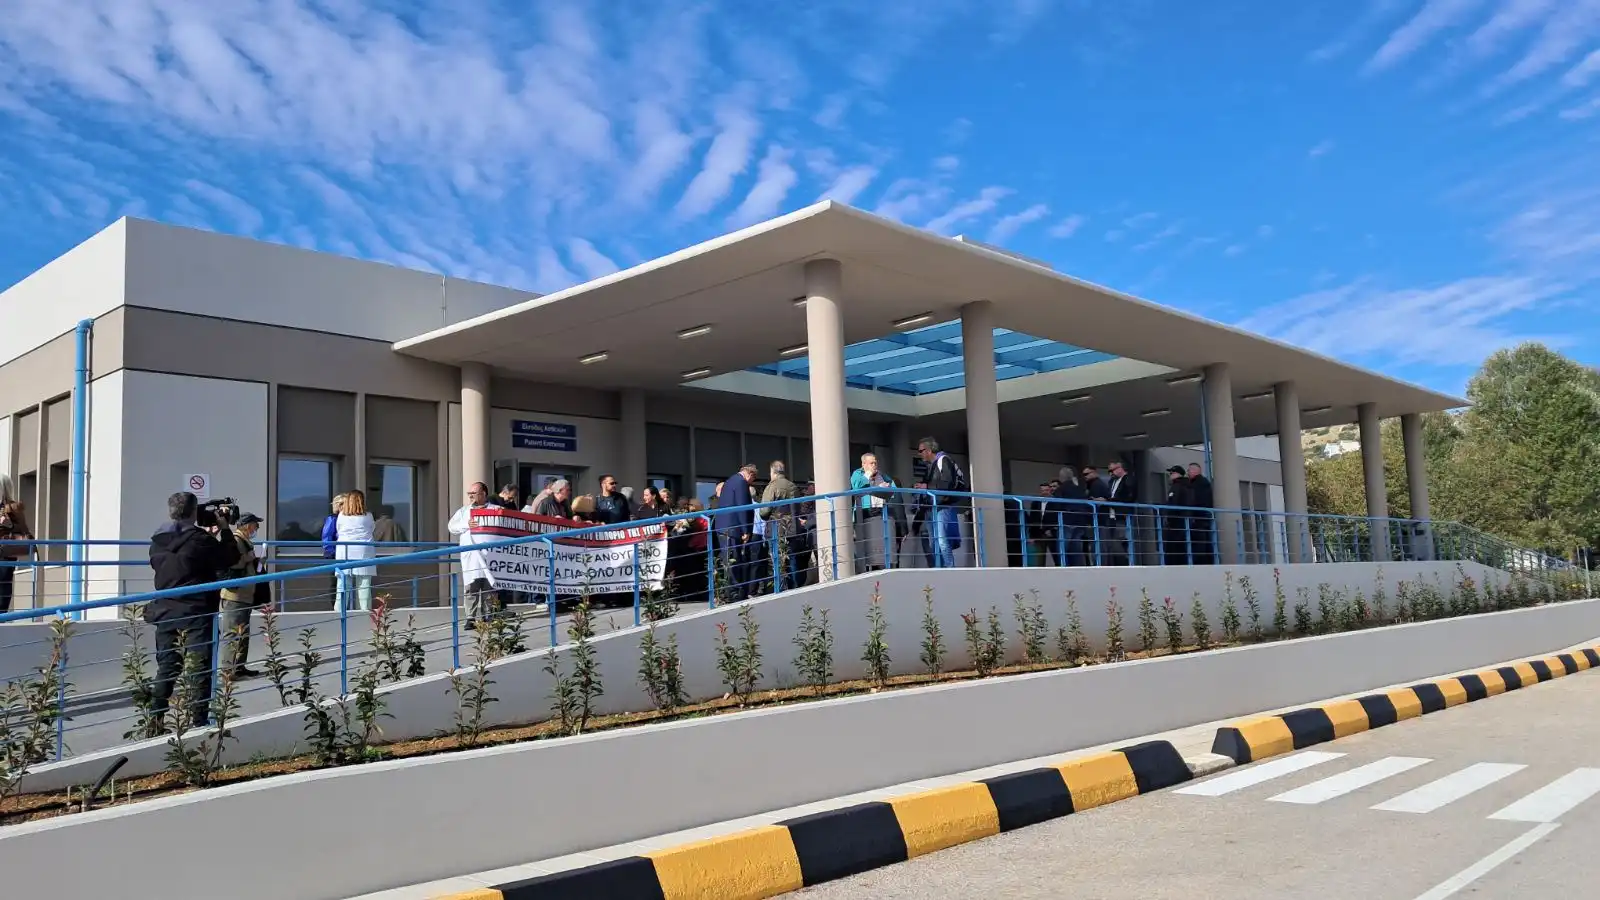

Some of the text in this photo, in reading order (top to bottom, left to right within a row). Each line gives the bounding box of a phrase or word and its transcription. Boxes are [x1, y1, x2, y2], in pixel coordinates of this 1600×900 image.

[524, 439, 565, 448] Patient Entrance
[627, 527, 641, 538] ΤΗΣ
[531, 547, 592, 563] ΠΡΟΛΗΨΕΙΣ
[485, 559, 530, 575] ΩΡΕΑΝ
[532, 564, 562, 580] ΥΓΕΑ
